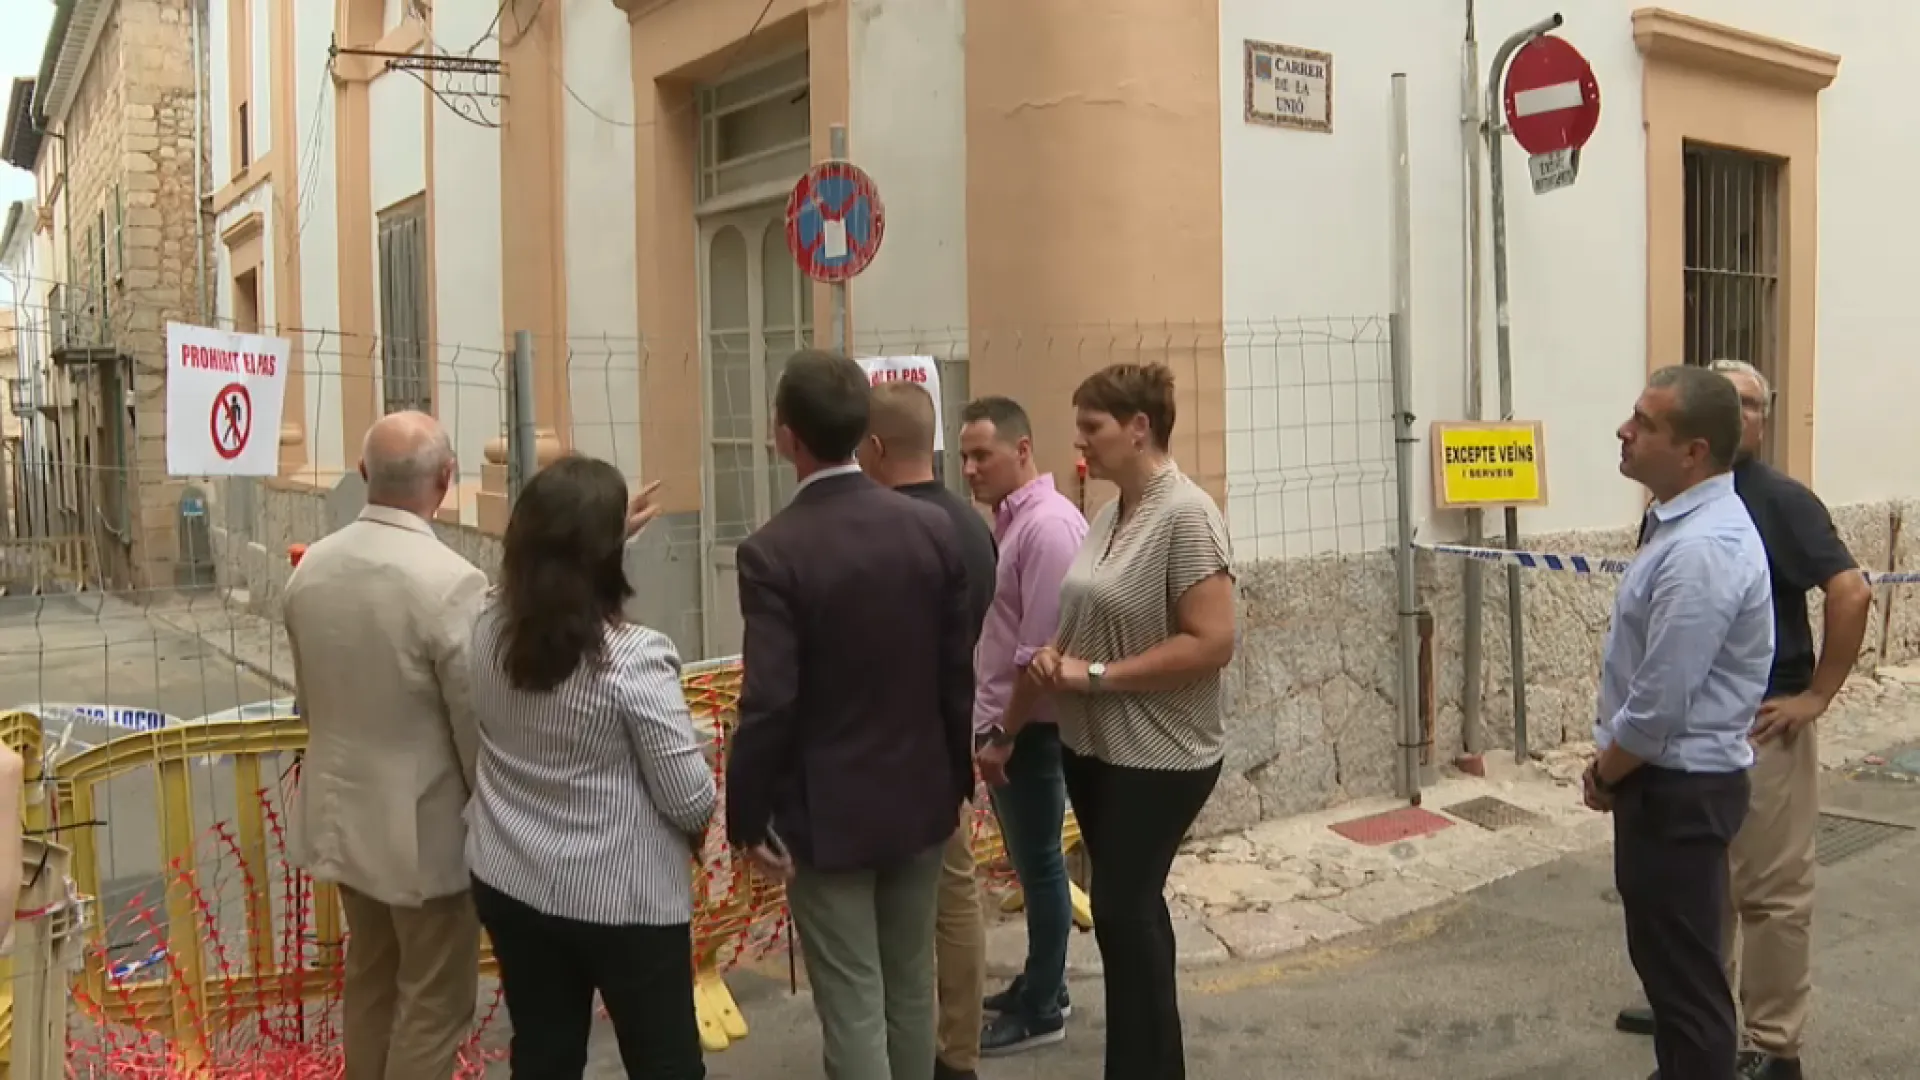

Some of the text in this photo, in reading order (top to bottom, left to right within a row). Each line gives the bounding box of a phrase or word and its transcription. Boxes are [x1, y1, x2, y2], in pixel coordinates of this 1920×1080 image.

[1275, 57, 1323, 79] CARRER
[1275, 77, 1309, 96] DE LA
[1276, 95, 1304, 114] UNIÓ
[182, 343, 276, 376] PROHIBIT EL PAS
[902, 366, 926, 382] PAS
[1445, 445, 1496, 463] EXCEPTE
[1469, 468, 1514, 478] SERVEIS
